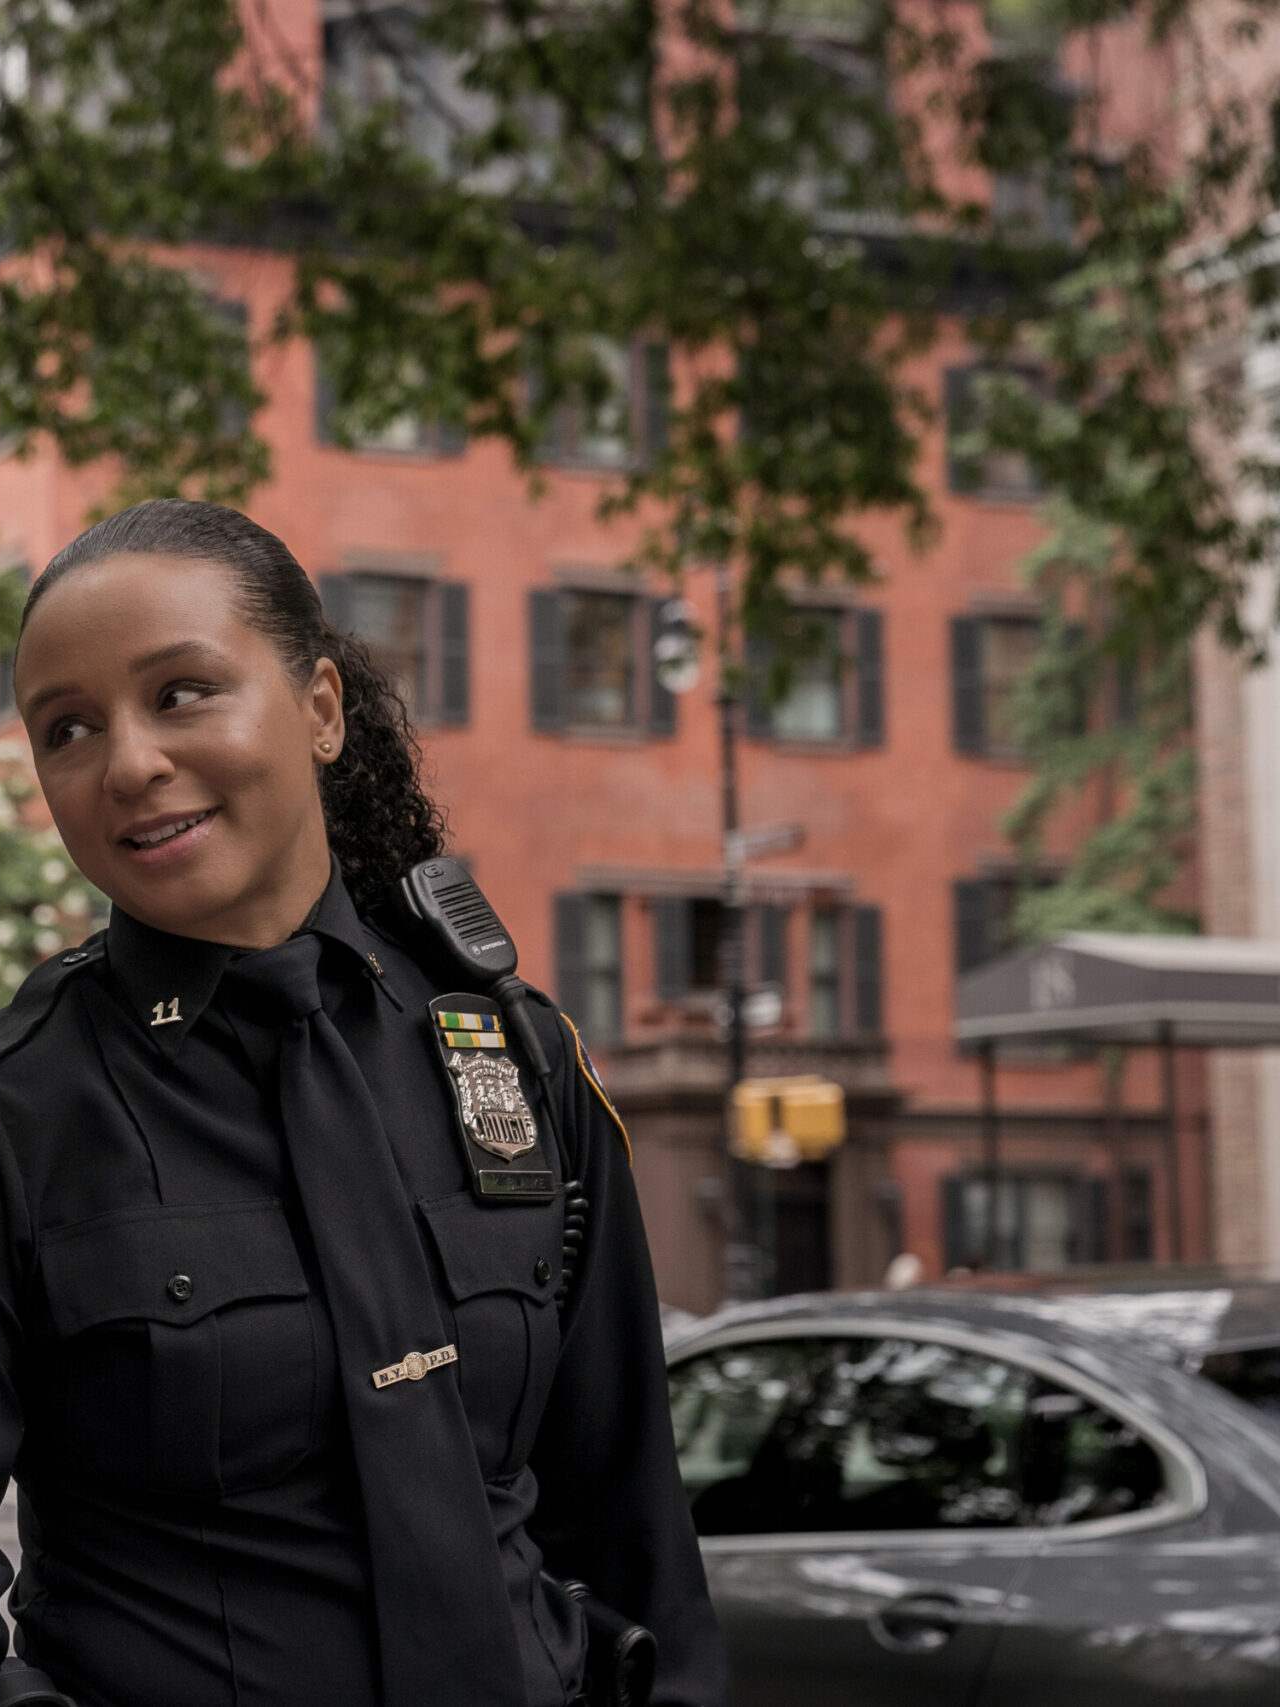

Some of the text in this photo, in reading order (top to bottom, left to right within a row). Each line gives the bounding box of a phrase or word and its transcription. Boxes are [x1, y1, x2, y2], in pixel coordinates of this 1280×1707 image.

[151, 997, 184, 1026] 11
[379, 1350, 455, 1384] N.Y. P.D.
